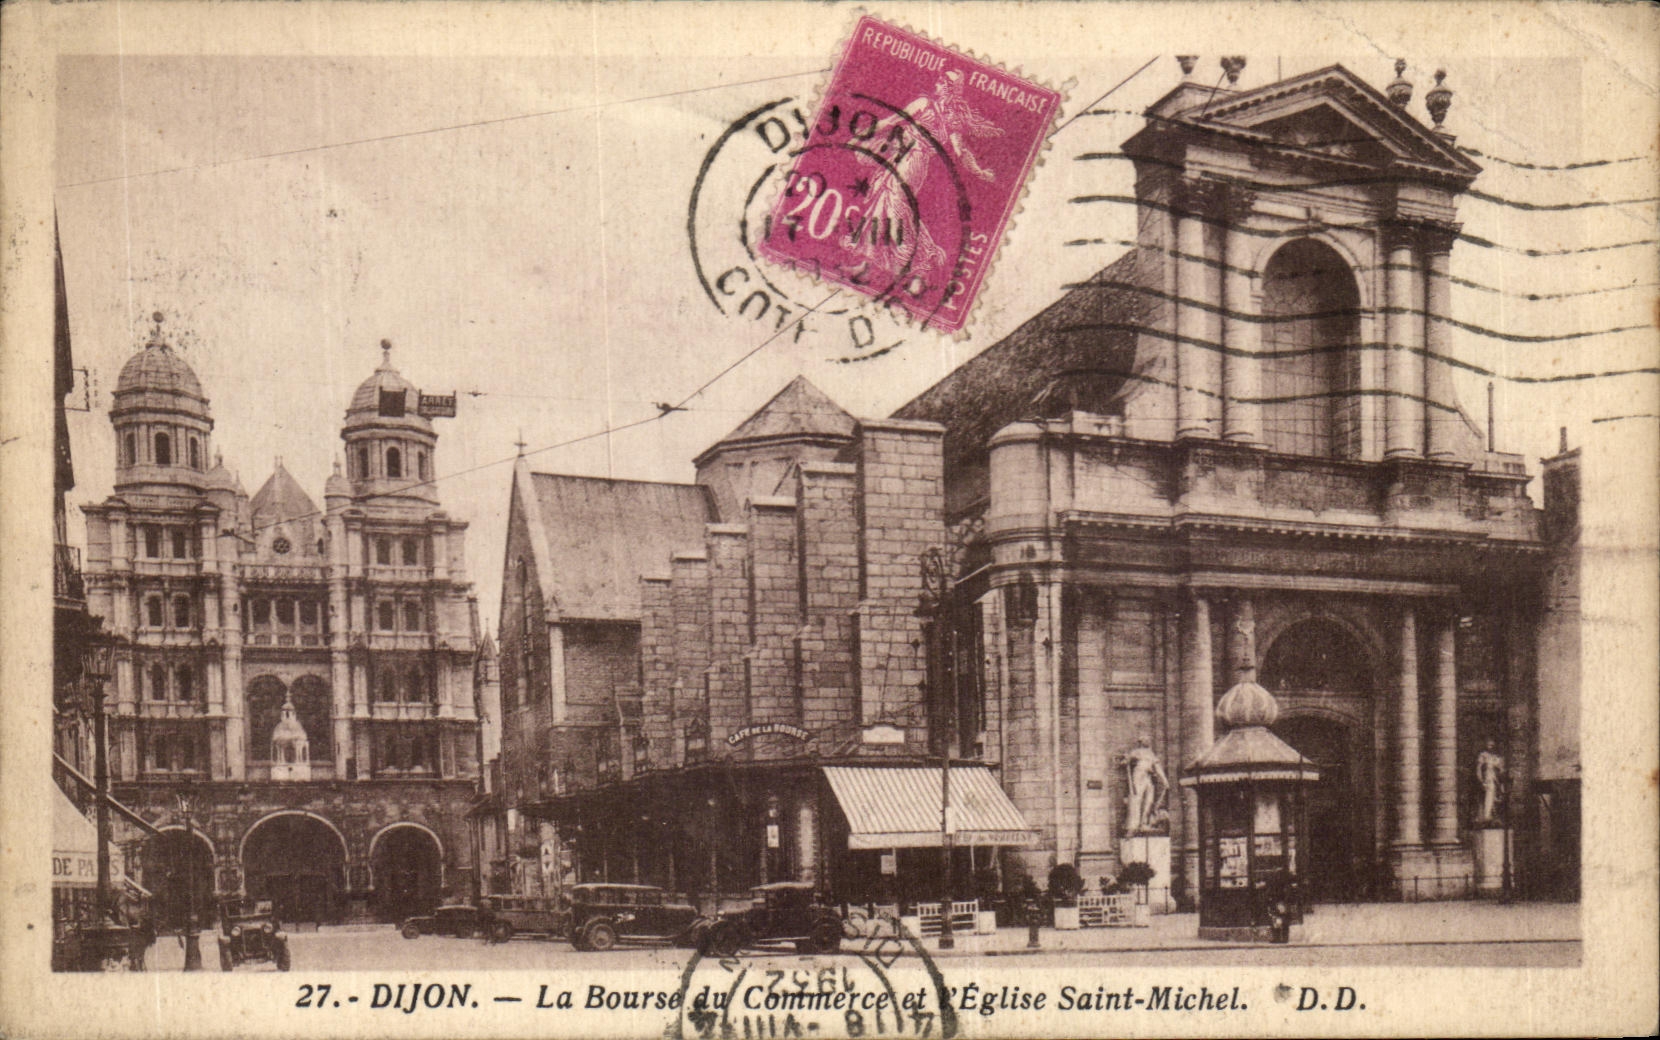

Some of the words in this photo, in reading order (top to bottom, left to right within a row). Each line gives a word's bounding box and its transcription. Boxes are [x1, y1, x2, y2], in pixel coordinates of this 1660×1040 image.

[862, 27, 948, 72] REPUBLIQUE
[756, 105, 916, 164] DIJON
[762, 725, 772, 734] LA
[773, 723, 809, 741] BOURSE
[52, 857, 72, 876] DE
[78, 858, 120, 876] PAS
